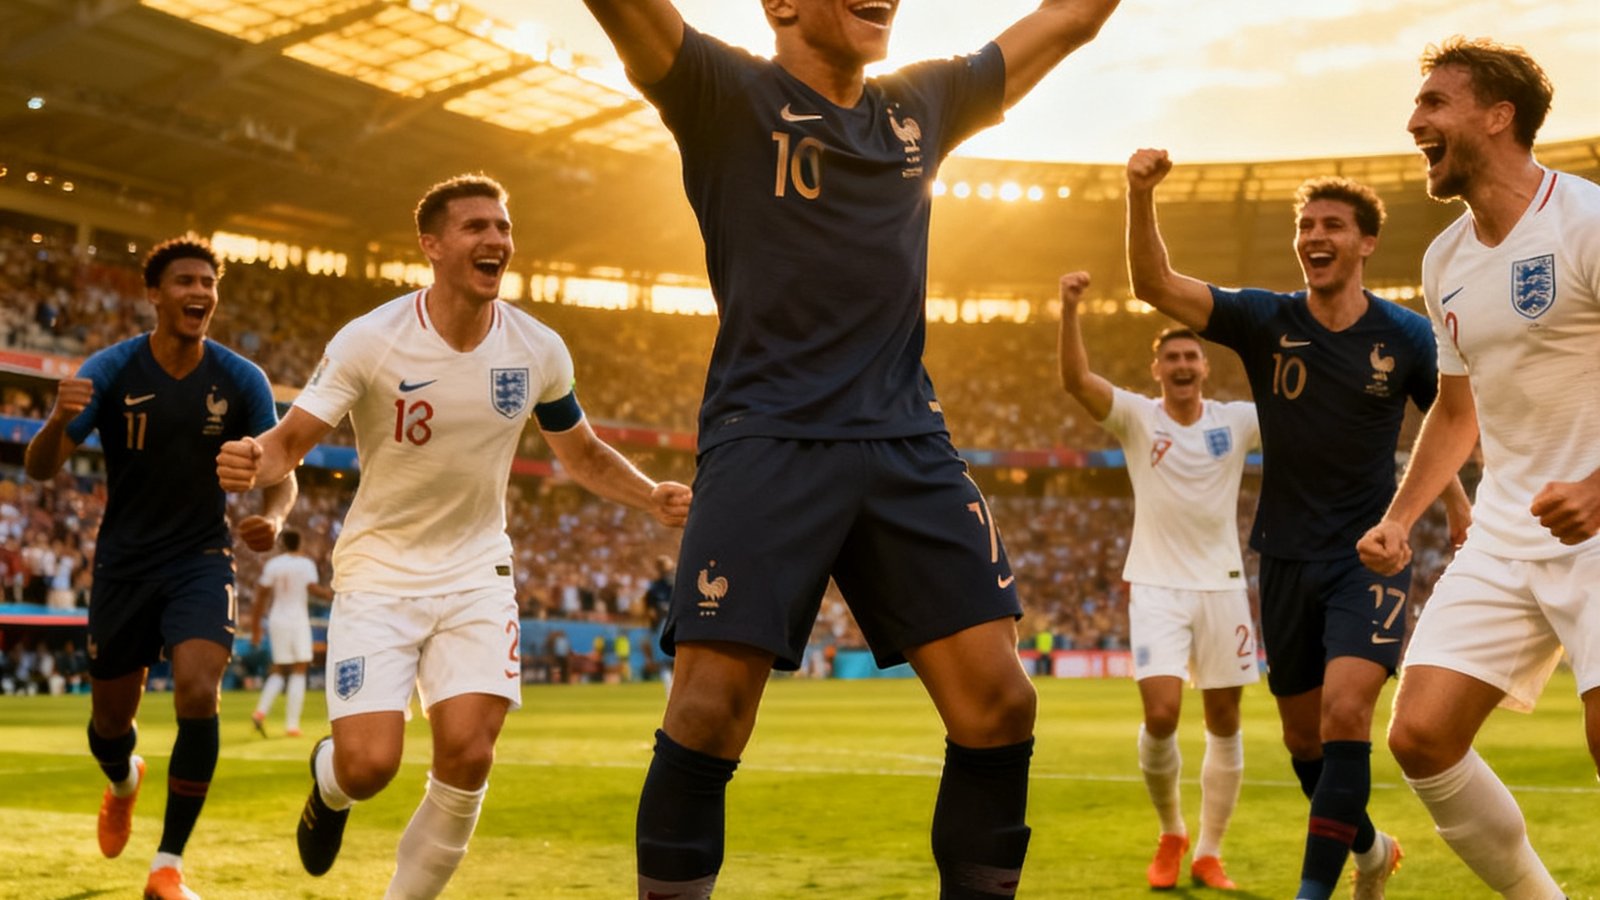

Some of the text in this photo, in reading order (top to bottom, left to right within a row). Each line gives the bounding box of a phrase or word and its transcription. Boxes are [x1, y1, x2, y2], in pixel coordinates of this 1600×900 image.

[772, 130, 822, 200] 10
[1272, 352, 1306, 400] 10
[123, 412, 147, 450] 11
[1235, 624, 1252, 659] 2
